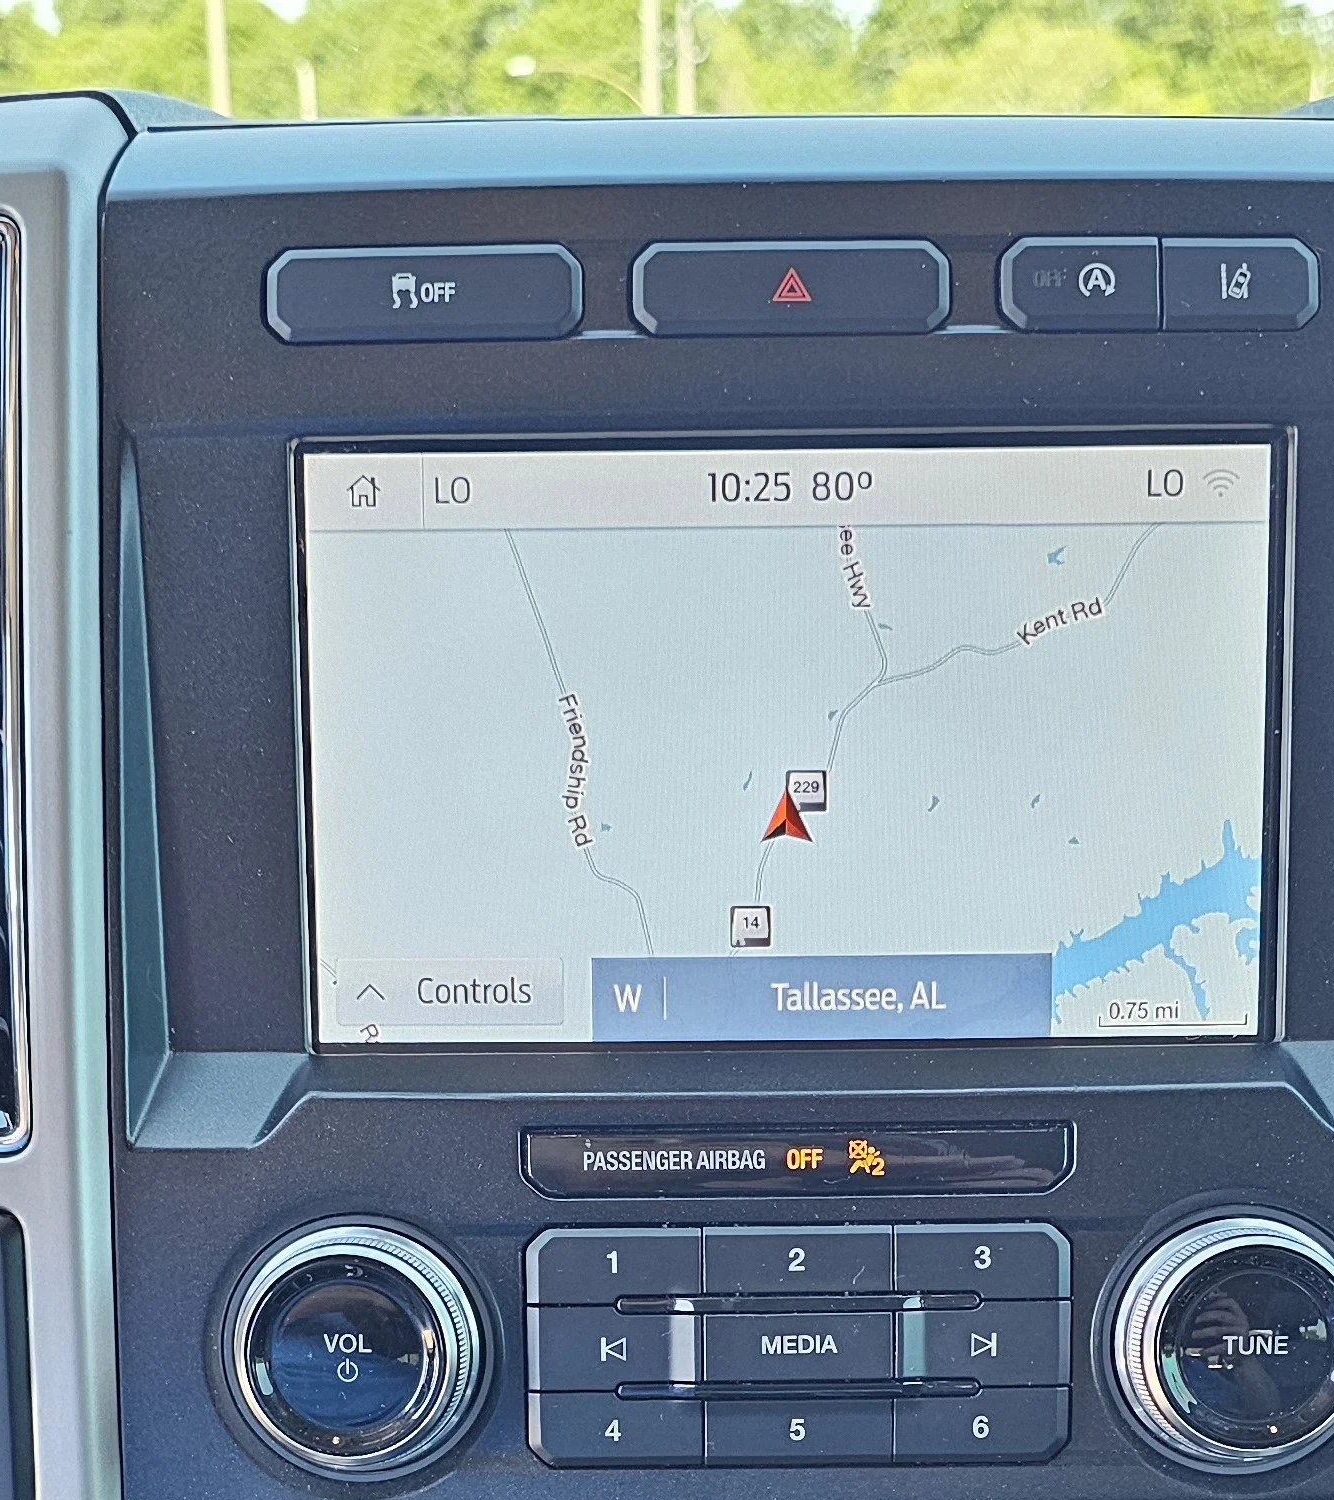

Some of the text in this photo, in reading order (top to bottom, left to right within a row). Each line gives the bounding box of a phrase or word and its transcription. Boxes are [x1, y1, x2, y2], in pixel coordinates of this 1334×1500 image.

[420, 281, 456, 304] OFF
[434, 476, 471, 504] LO
[707, 471, 792, 503] 10:25
[1147, 469, 1184, 497] LO
[838, 524, 871, 607] ee Hwy
[1017, 597, 1103, 645] Kent Rd
[558, 693, 594, 847] Friendship Rd
[793, 780, 820, 794] 229
[742, 916, 760, 930] 14
[417, 976, 532, 1005] Controls
[614, 983, 642, 1012] W
[770, 982, 947, 1014] Tallassee, AL
[1109, 1000, 1180, 1020] 0.75 mi
[583, 1147, 824, 1172] PASSENGER AIRBAG OFF
[606, 1250, 619, 1274] 1
[787, 1247, 805, 1272] 2
[973, 1246, 992, 1269] 3
[323, 1333, 372, 1354] VOL
[761, 1333, 837, 1355] MEDIA
[1223, 1335, 1289, 1355] TUNE
[604, 1419, 622, 1441] 4
[789, 1418, 806, 1442] 5
[972, 1416, 990, 1440] 6
